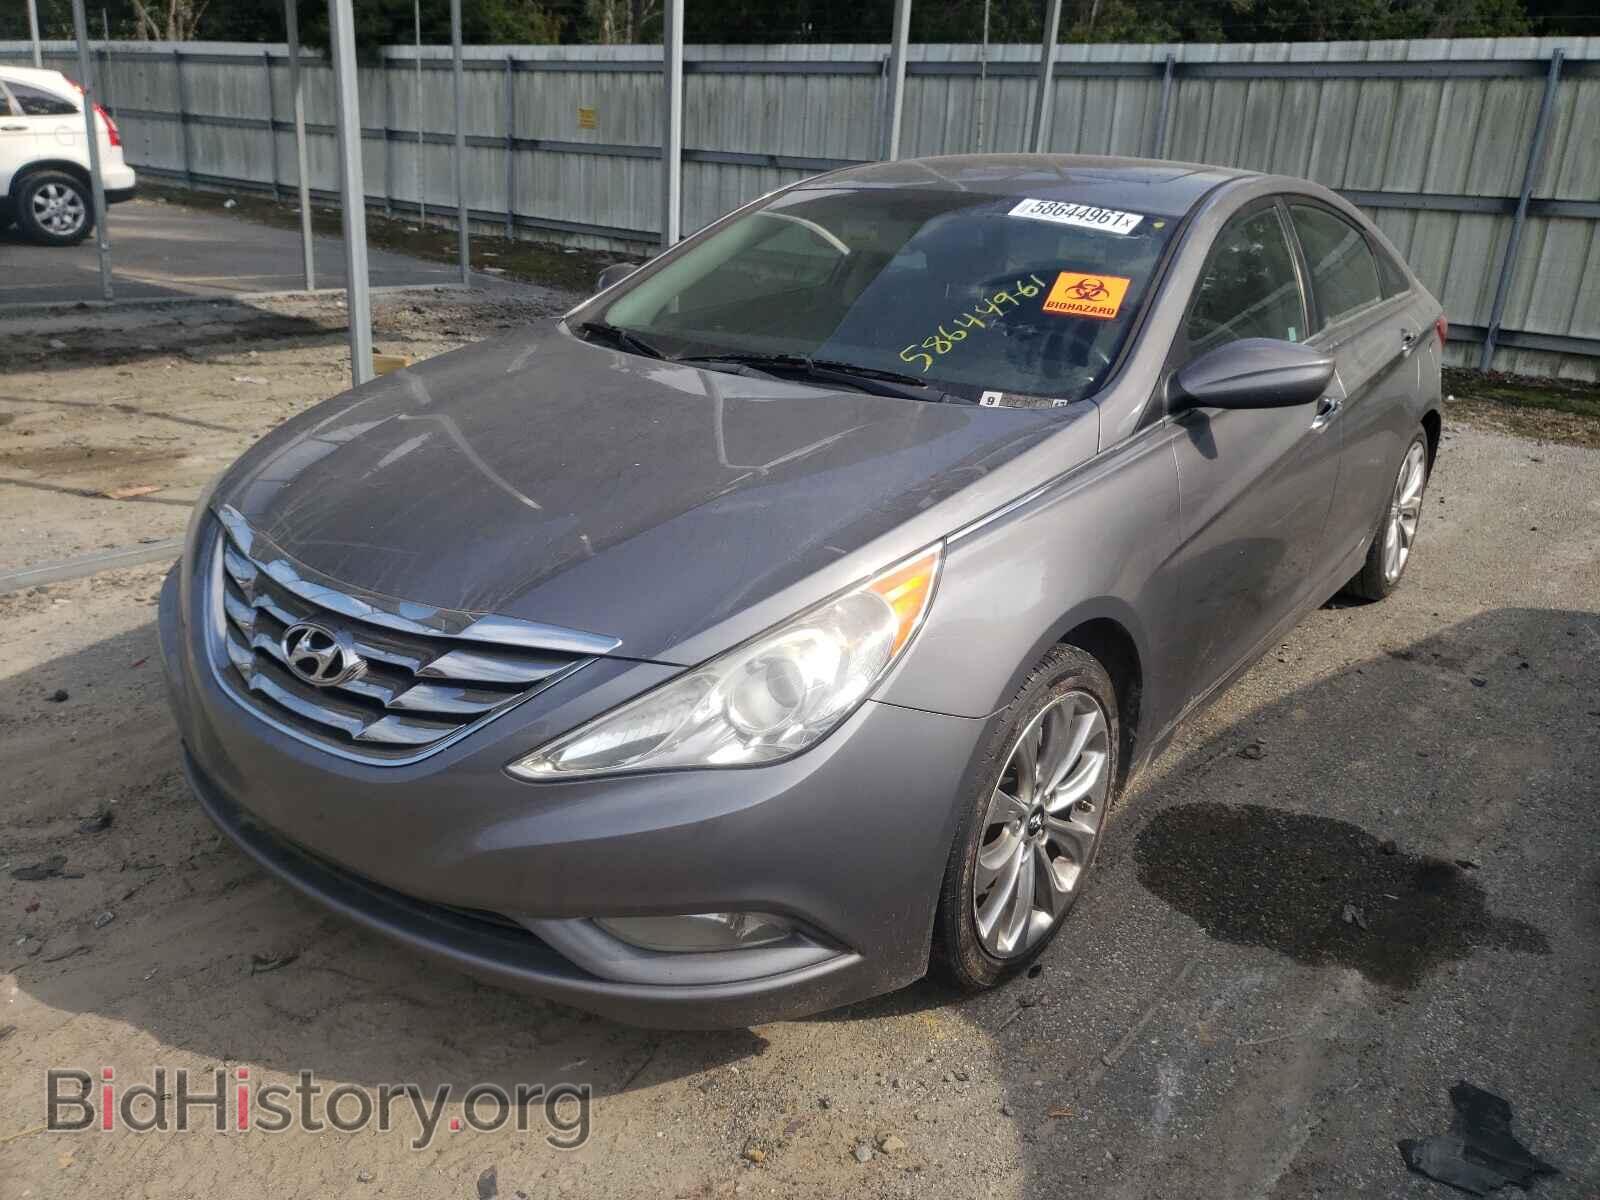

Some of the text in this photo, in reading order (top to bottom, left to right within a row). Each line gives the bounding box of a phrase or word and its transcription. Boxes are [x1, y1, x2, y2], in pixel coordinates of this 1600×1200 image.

[1031, 201, 1126, 226] 58644961
[1046, 301, 1116, 315] BIOHAZARD
[985, 396, 996, 406] 9
